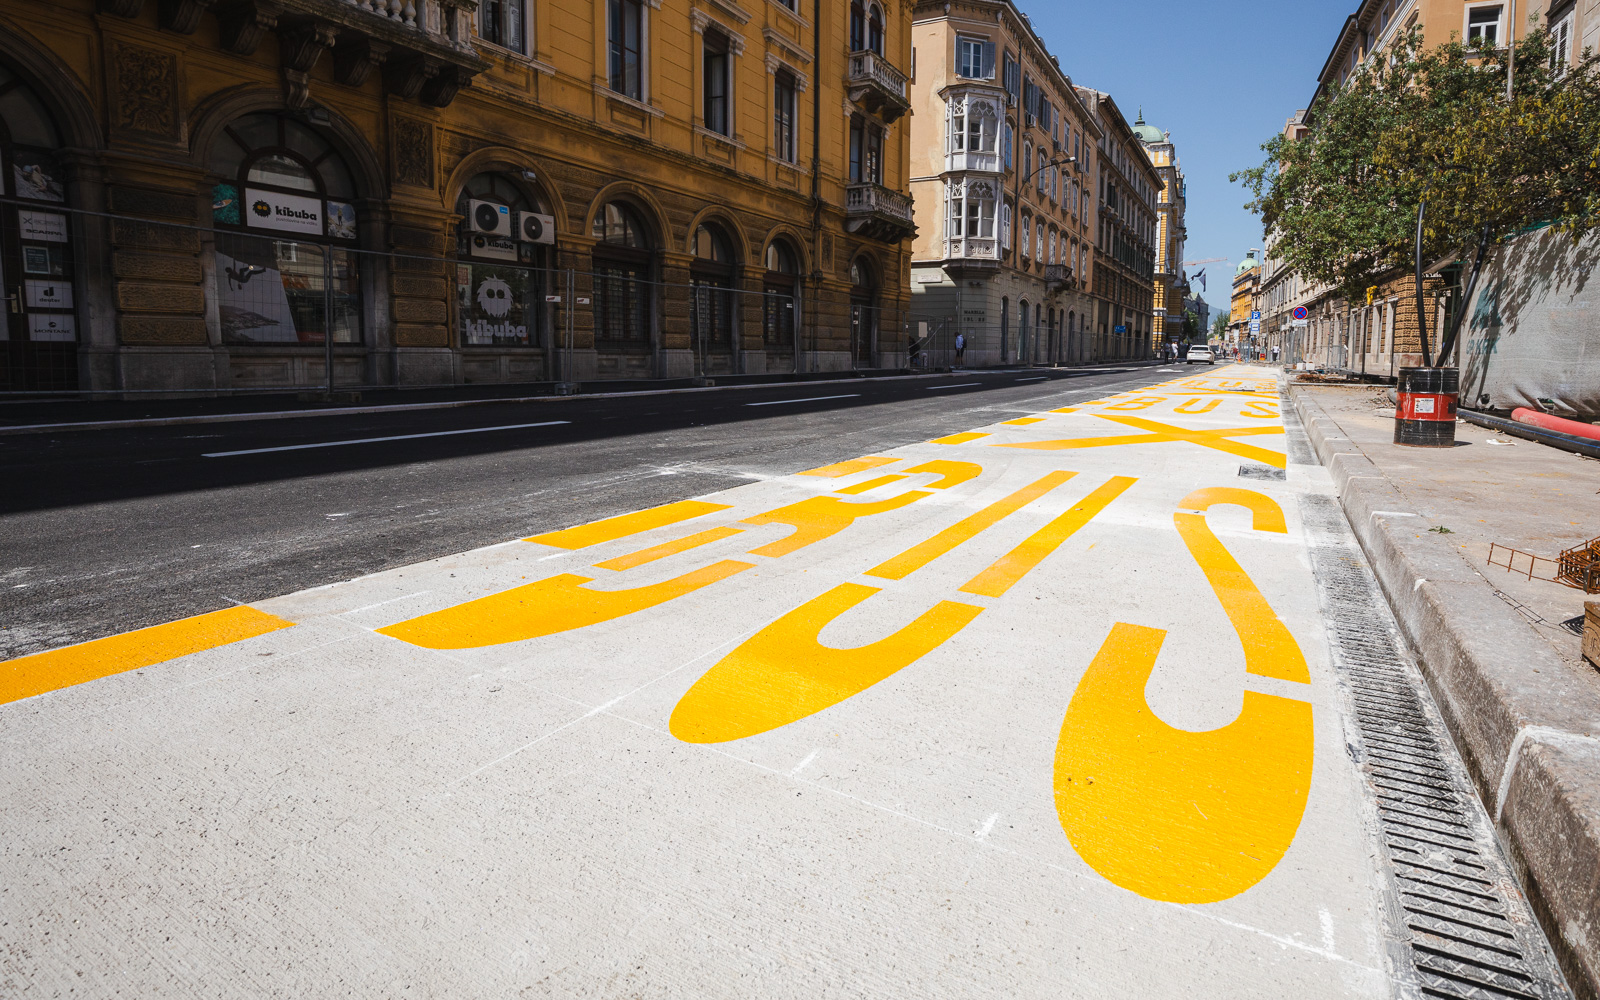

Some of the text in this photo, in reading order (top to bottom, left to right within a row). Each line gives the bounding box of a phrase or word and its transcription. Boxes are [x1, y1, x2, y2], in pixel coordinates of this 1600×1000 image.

[275, 205, 317, 221] kibuba
[26, 228, 63, 236] SCARPA
[465, 319, 527, 338] kibuba
[1104, 397, 1281, 418] BUS
[374, 460, 1314, 904] BUS
